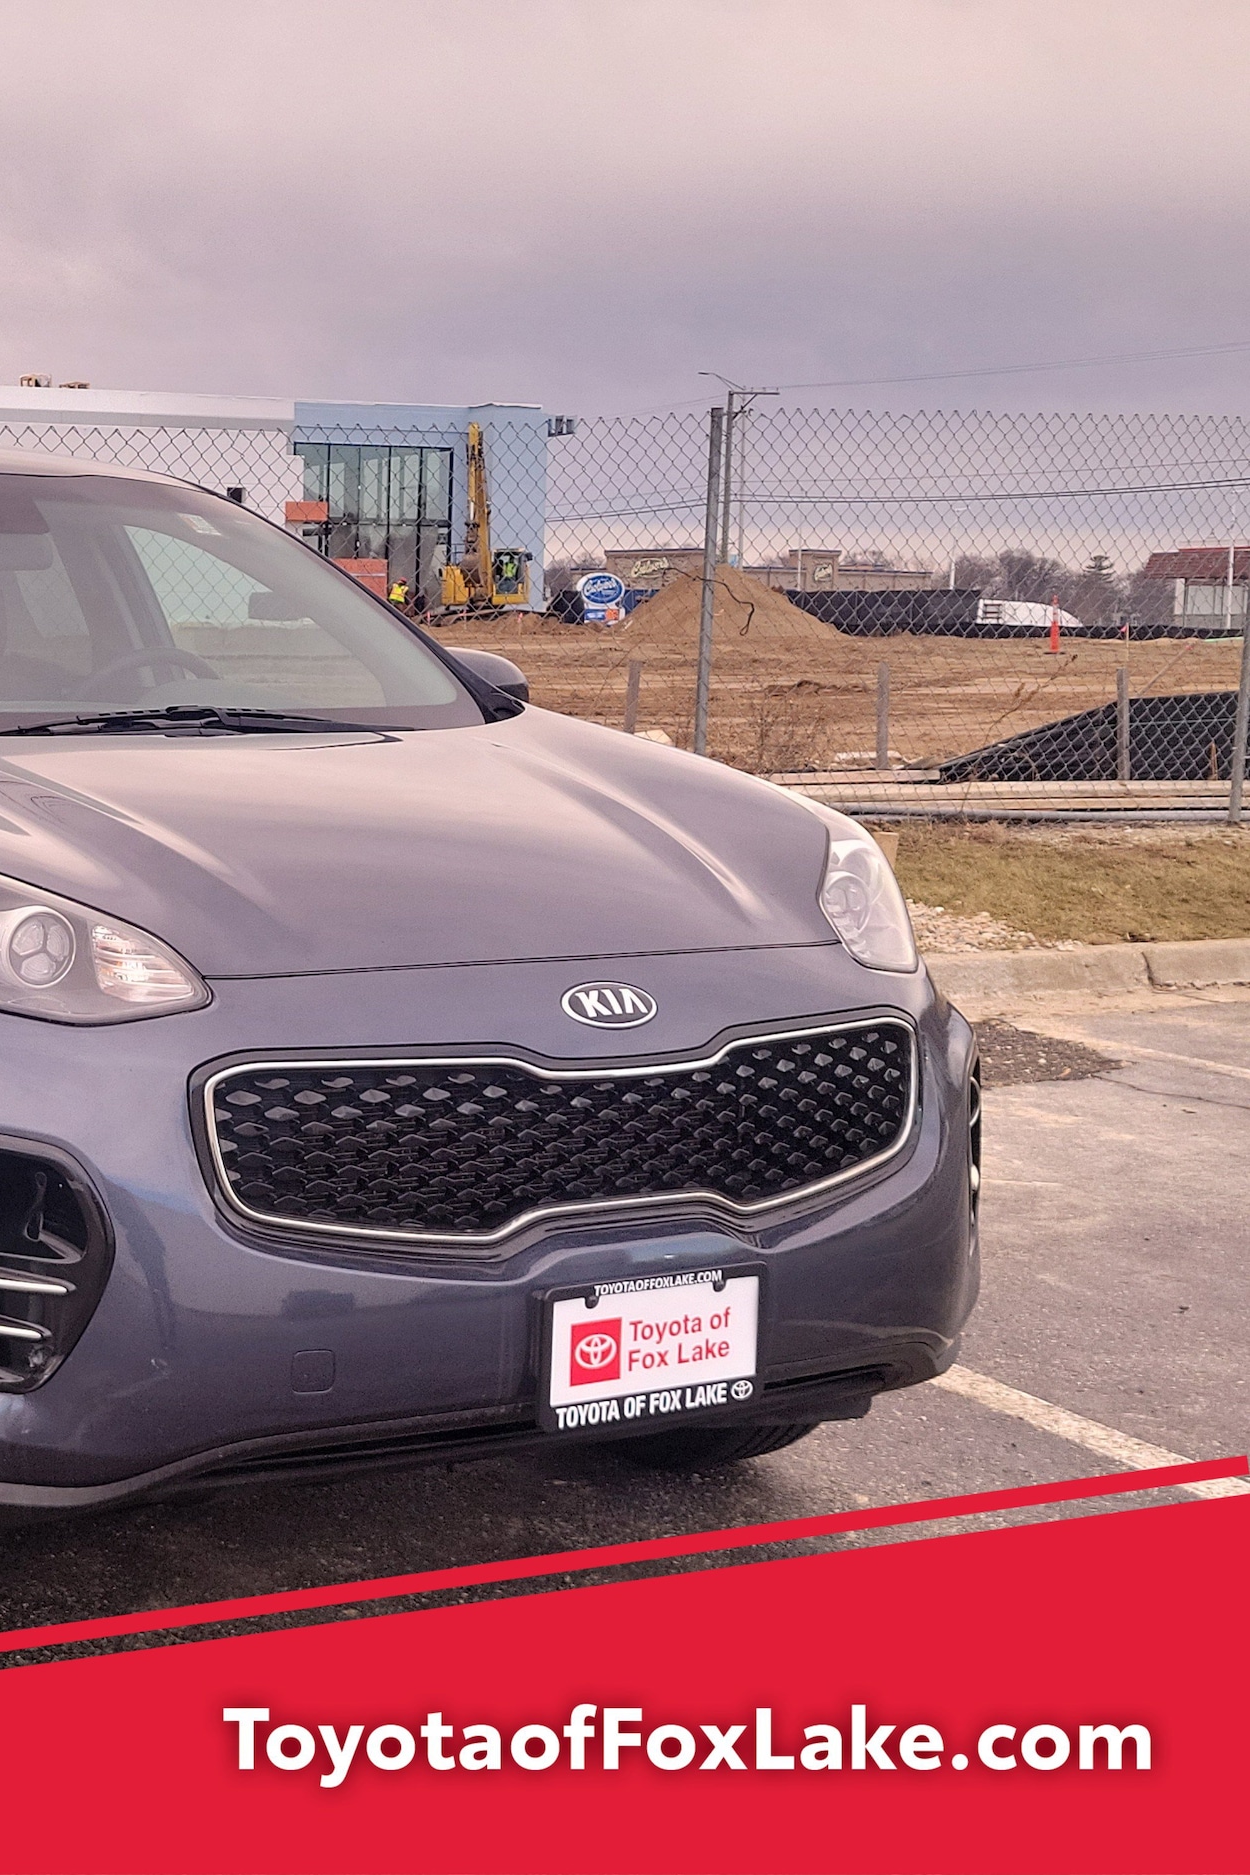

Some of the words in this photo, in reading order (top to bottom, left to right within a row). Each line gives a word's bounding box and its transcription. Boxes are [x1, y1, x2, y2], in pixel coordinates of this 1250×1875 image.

[575, 988, 649, 1018] KIA
[594, 1269, 723, 1297] TOYOTAOFFOXLAKE.COM
[629, 1315, 702, 1345] Toyota
[710, 1306, 731, 1330] of
[628, 1350, 669, 1372] Fox
[678, 1339, 730, 1364] Lake
[556, 1400, 620, 1429] TOYOTA
[624, 1395, 646, 1418] OF
[650, 1391, 682, 1415] FOX
[686, 1382, 728, 1408] LAKE
